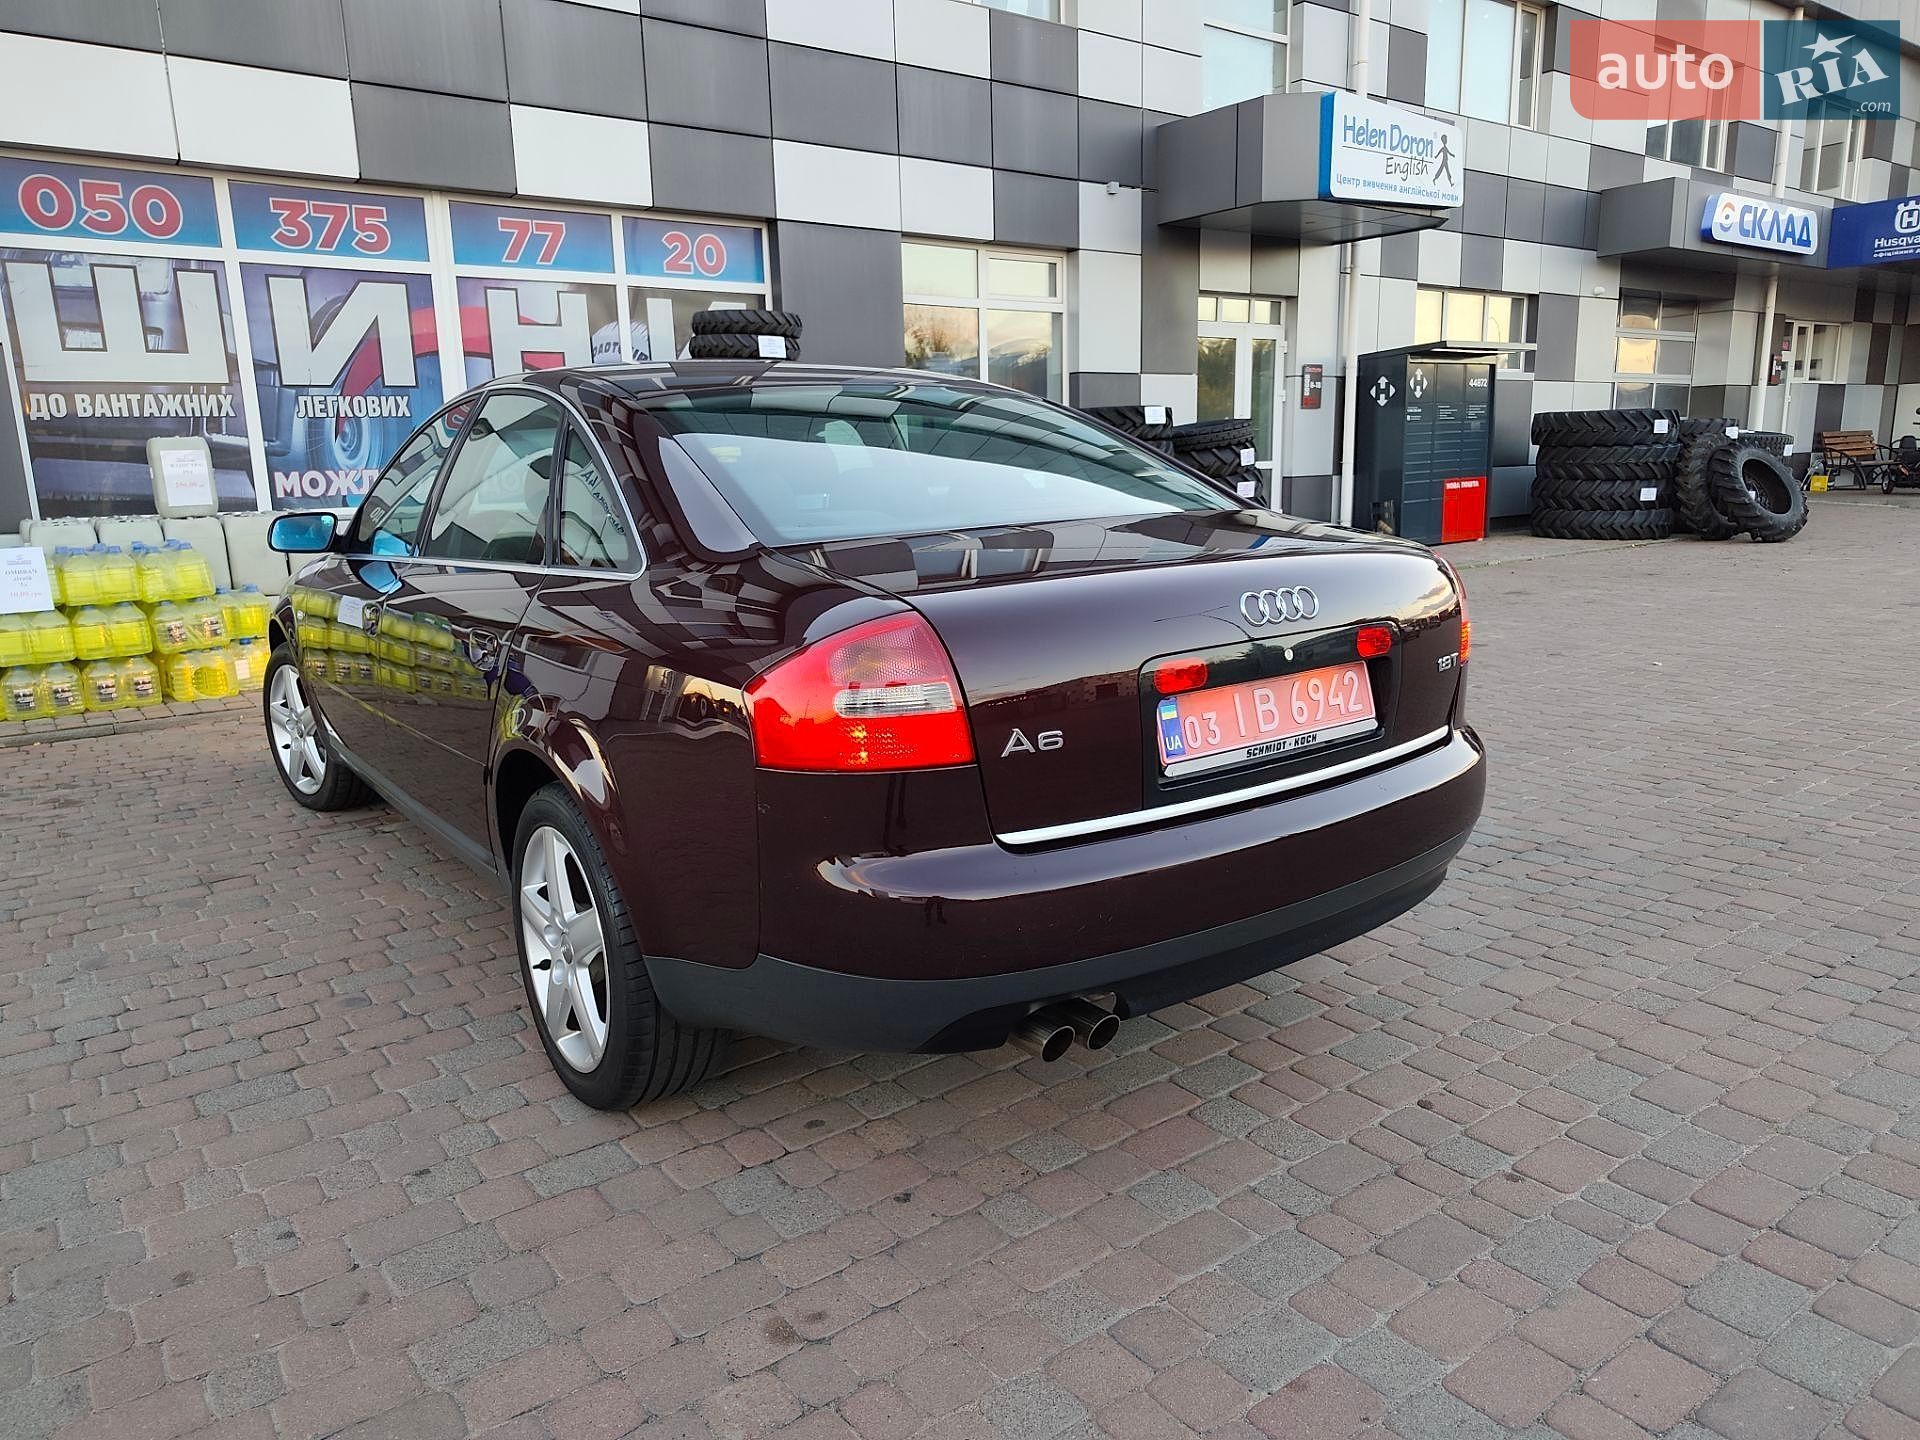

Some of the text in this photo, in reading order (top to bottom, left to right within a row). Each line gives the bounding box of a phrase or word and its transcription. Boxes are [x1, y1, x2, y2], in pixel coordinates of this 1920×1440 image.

[1343, 114, 1434, 158] Helen Doron
[1385, 157, 1429, 182] English
[1336, 173, 1459, 202] Центр вивчення англійської мови
[18, 174, 728, 277] 050 375 77 20
[1738, 204, 1812, 249] СКЛАД
[28, 393, 237, 421] ДО ВАНТАЖНИХ
[297, 395, 412, 419] ЛЕГКОВИХ
[1183, 710, 1222, 750] 03
[1290, 670, 1364, 726] 6942
[1000, 727, 1064, 758] A6
[1166, 734, 1182, 751] UA
[1246, 732, 1318, 759] SCHMIDT KOCH
